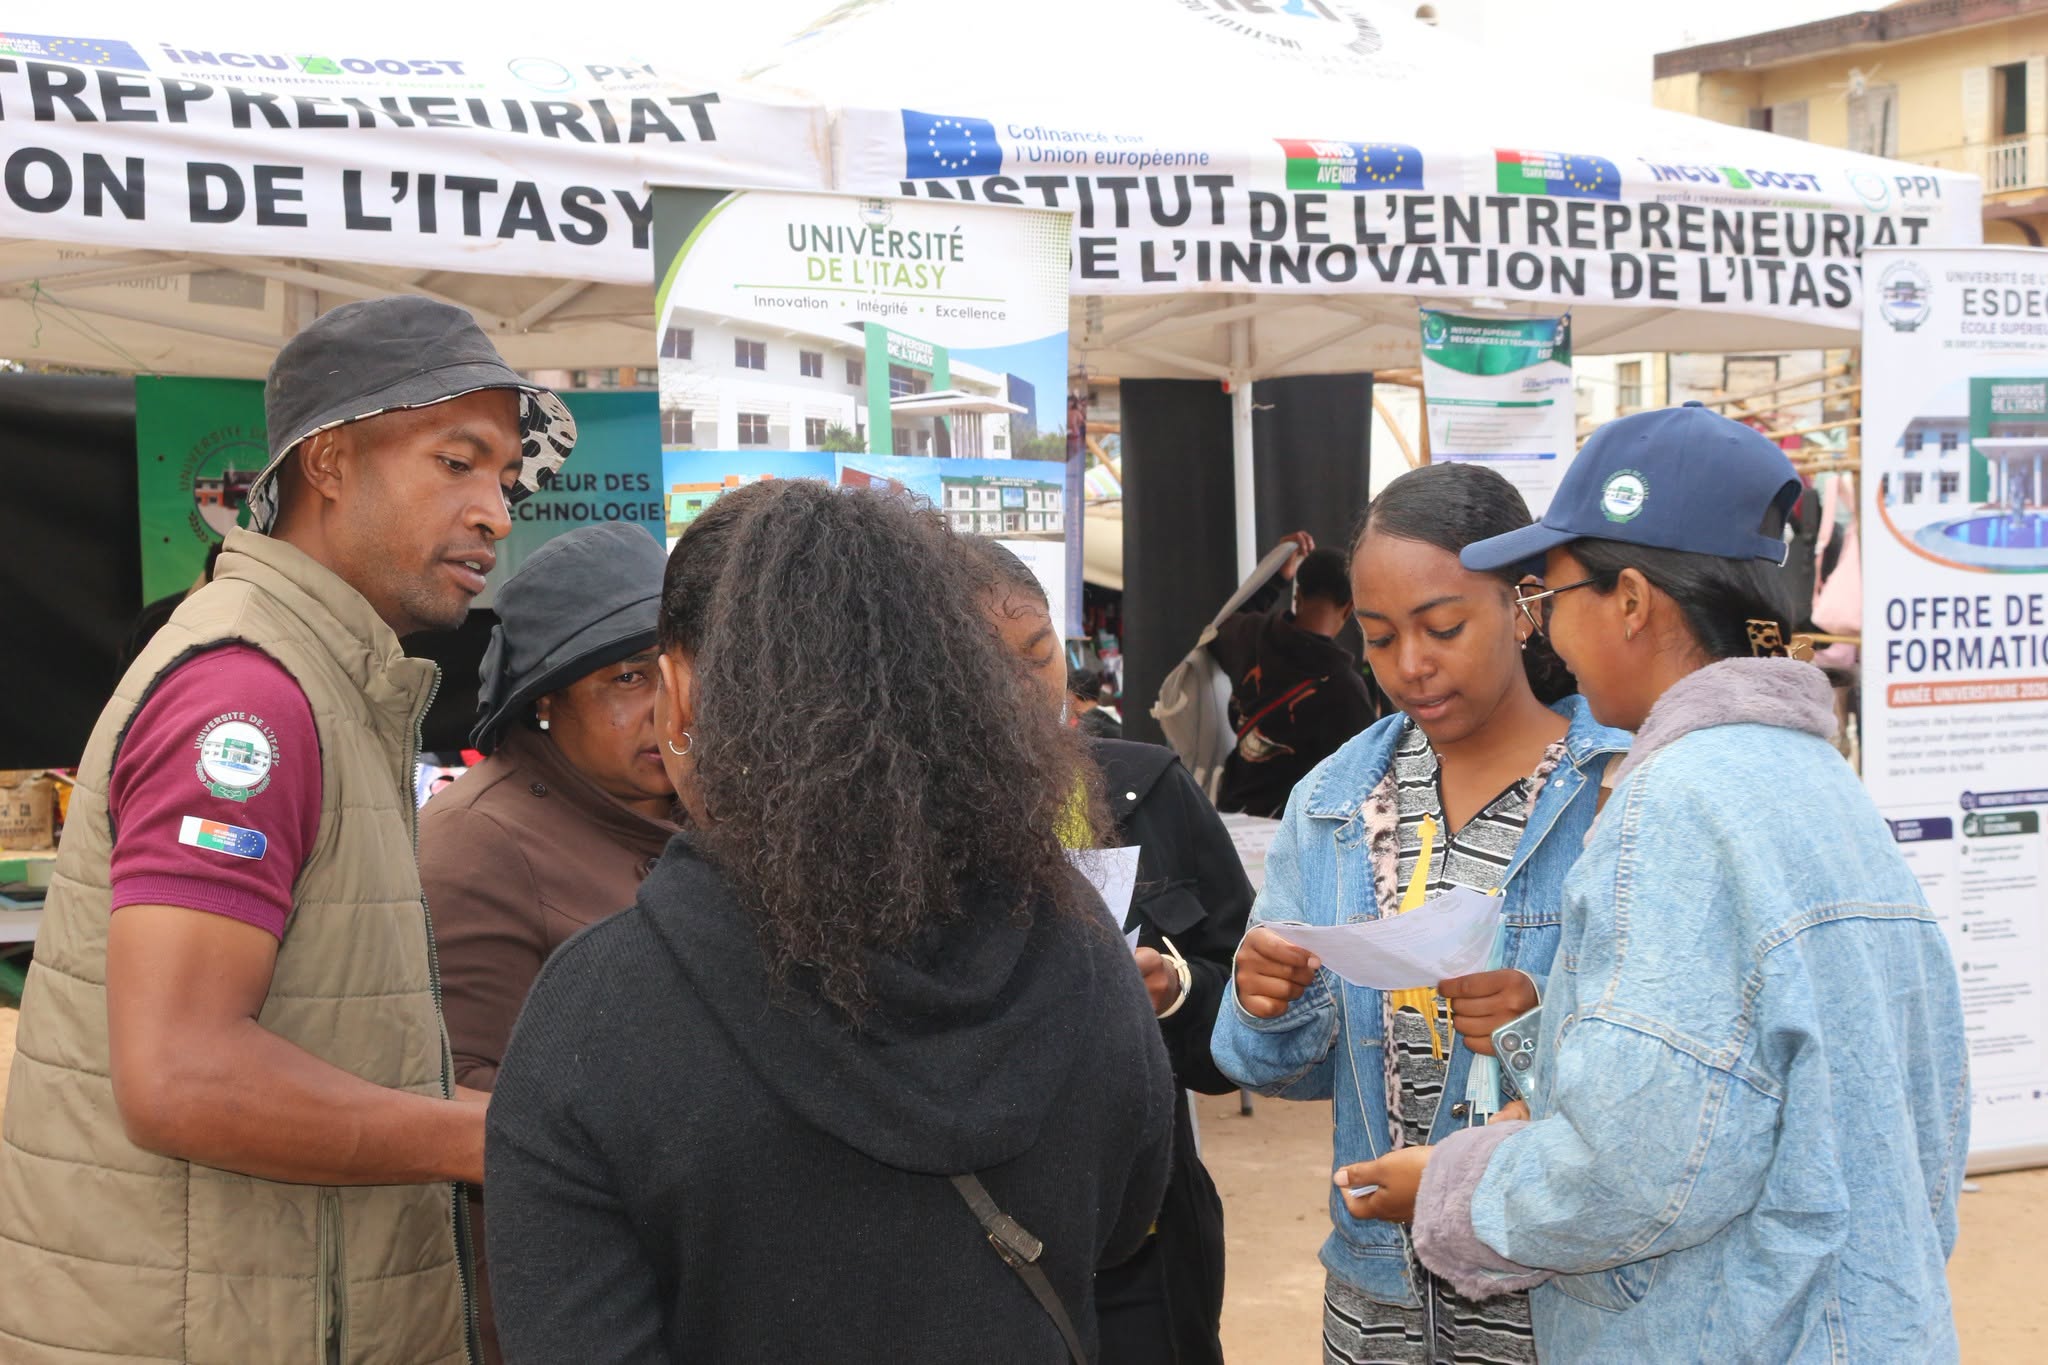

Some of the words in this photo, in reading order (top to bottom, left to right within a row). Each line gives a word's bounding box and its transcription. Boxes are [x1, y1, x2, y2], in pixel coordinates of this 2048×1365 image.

[1015, 145, 1087, 165] l'Union
[1094, 147, 1210, 171] européenne
[1316, 165, 1357, 184] AVENIR
[1893, 175, 1941, 198] PPI
[187, 161, 308, 230] DE
[343, 169, 654, 250] L'ITASY
[1249, 191, 1329, 244] DE
[1353, 193, 1930, 258] L'ENTREPRENEURIAT
[787, 223, 965, 263] UNIVERSITÉ
[807, 256, 843, 283] DE
[853, 258, 946, 289] L'ITASY
[1141, 239, 1587, 298] L'INNOVATION
[1610, 252, 1679, 302] DE
[1699, 256, 1863, 310] L'ITAS
[753, 295, 829, 310] Innovation
[856, 299, 908, 317] Intégrité
[935, 304, 1007, 321] Excellence
[1962, 288, 2048, 317] ESDE
[604, 473, 650, 492] DES
[1887, 595, 1992, 631] OFFRE
[2005, 594, 2044, 626] DE
[193, 711, 246, 750] UNIVERSITE
[248, 713, 264, 727] DE
[263, 726, 280, 767] L'ITASY
